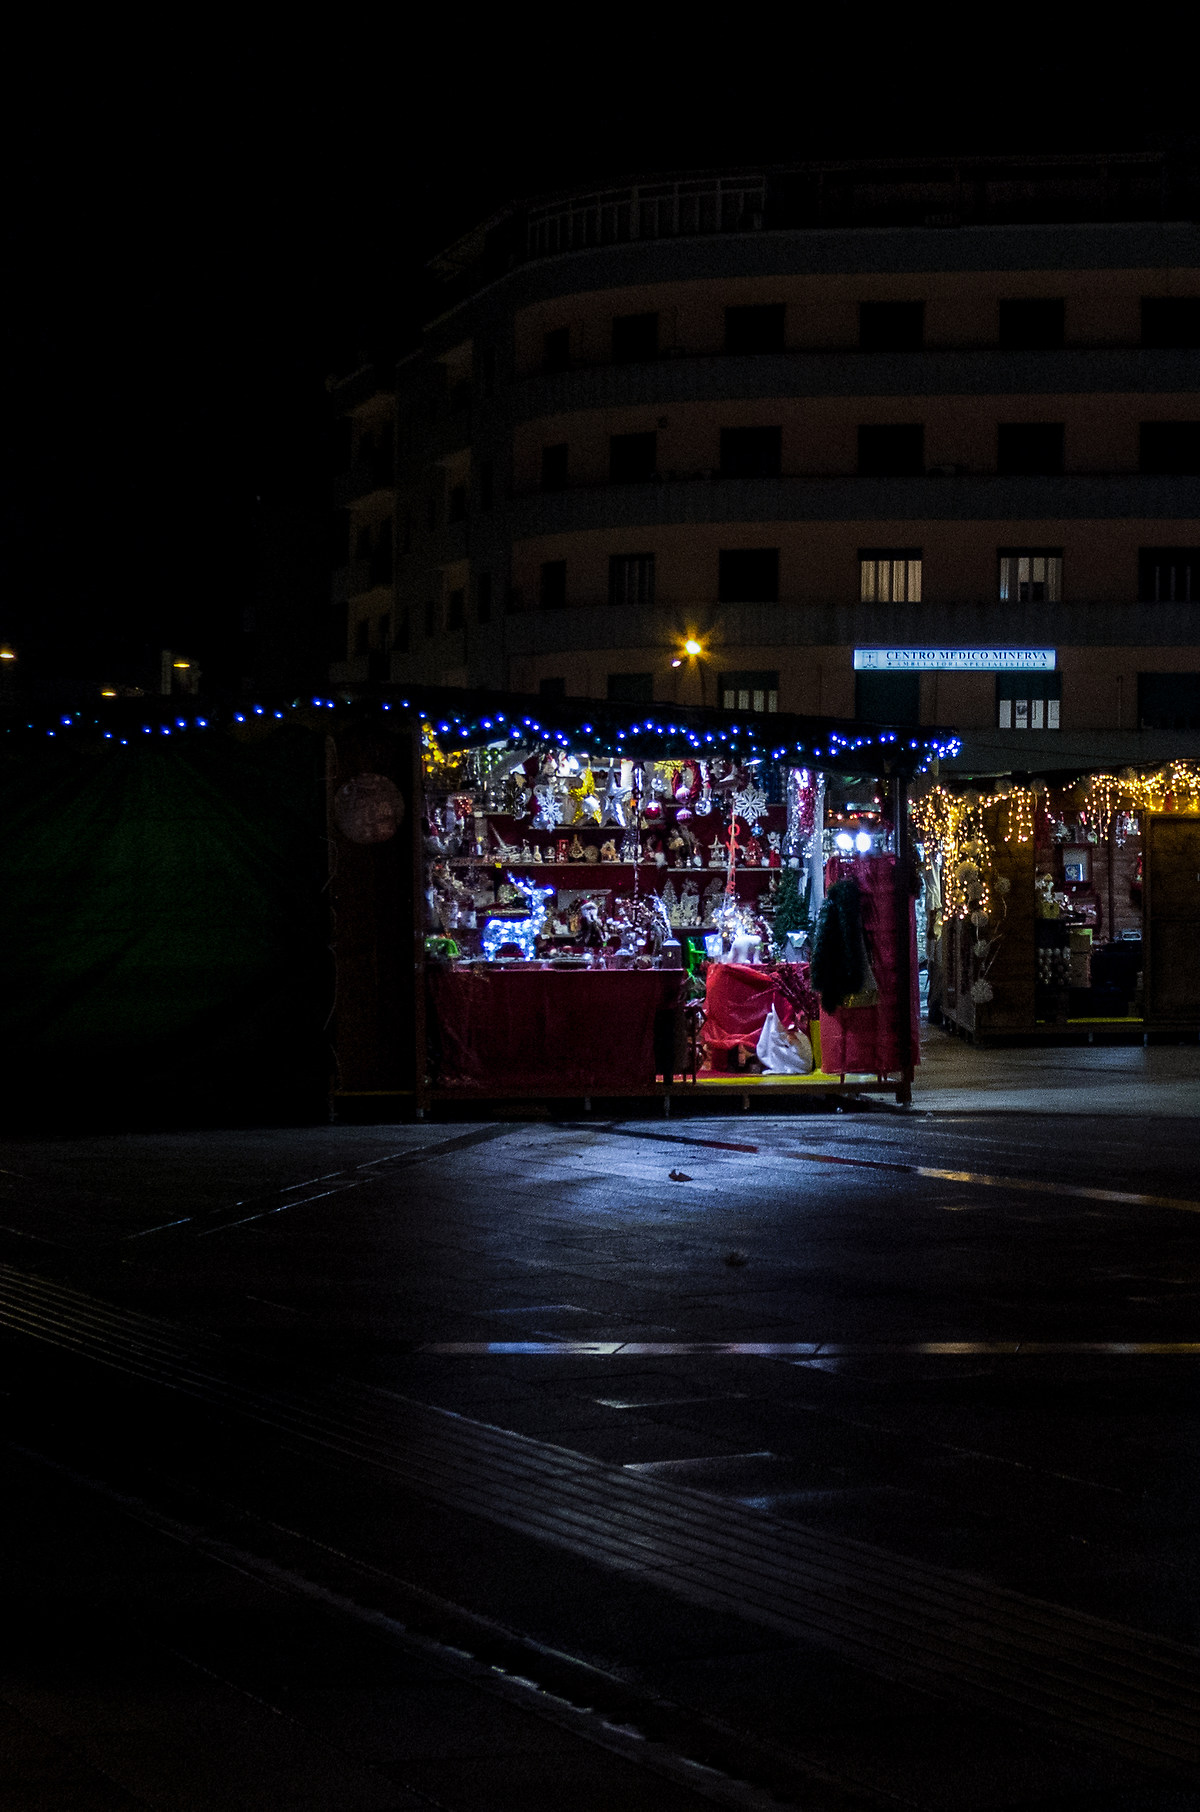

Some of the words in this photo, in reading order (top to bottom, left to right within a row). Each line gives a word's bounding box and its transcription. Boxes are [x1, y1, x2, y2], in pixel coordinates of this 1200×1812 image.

[886, 651, 936, 660] CENTRO
[940, 651, 989, 660] MEDICO
[993, 651, 1047, 660] MINERVA
